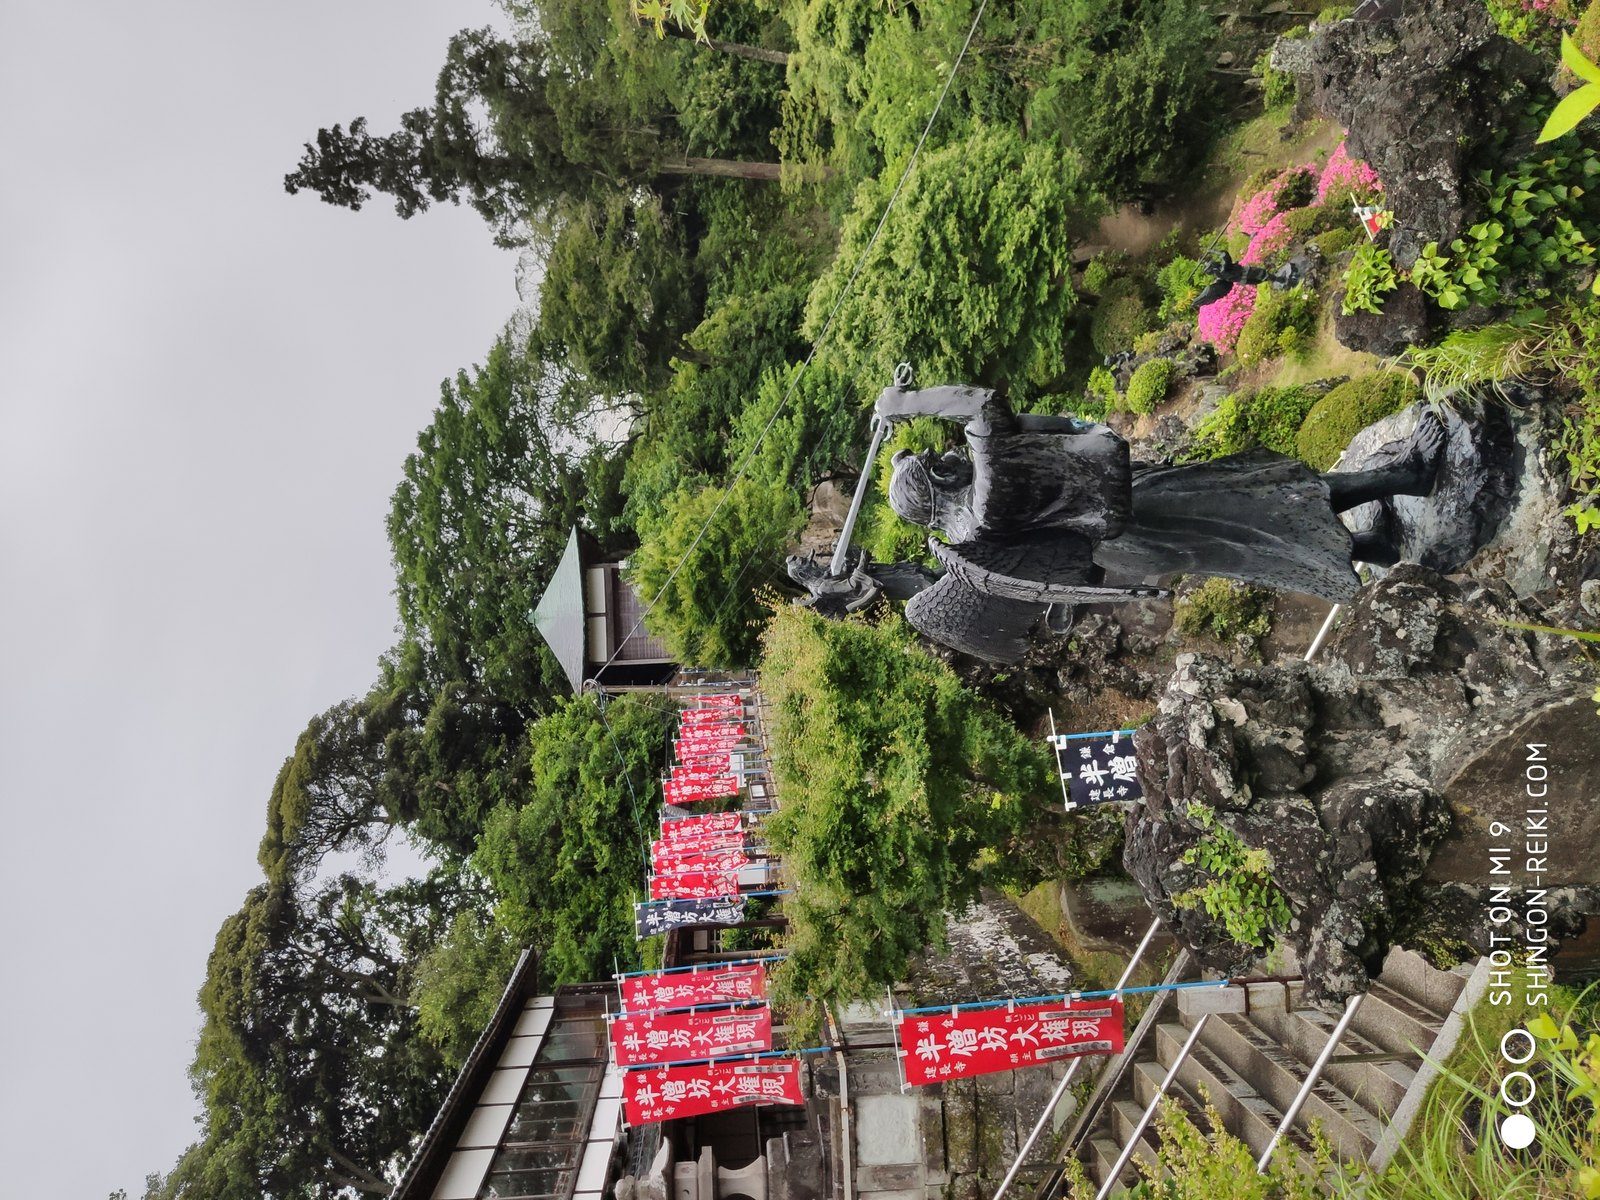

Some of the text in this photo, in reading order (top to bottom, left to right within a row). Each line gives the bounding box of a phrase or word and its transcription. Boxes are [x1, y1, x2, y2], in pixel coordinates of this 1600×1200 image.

[1079, 743, 1115, 759] 鎌倉
[1080, 756, 1138, 786] 半僧
[1088, 785, 1128, 801] 建長寺
[633, 978, 752, 1006] 半僧坊大権現
[625, 1020, 652, 1032] 鎌倉
[917, 1019, 954, 1033] 鎌倉
[1005, 1014, 1036, 1023] 願いごと
[622, 1021, 757, 1052] 半僧坊大権現
[915, 1017, 1101, 1063] 半僧坊大権現
[628, 1052, 658, 1062] 建長寺
[1010, 1051, 1032, 1063] 願主
[924, 1060, 966, 1079] 建長寺
[637, 1072, 667, 1084] 鎌倉
[634, 1075, 786, 1107] 半僧坊大権現
[640, 1105, 676, 1120] 建長寺
